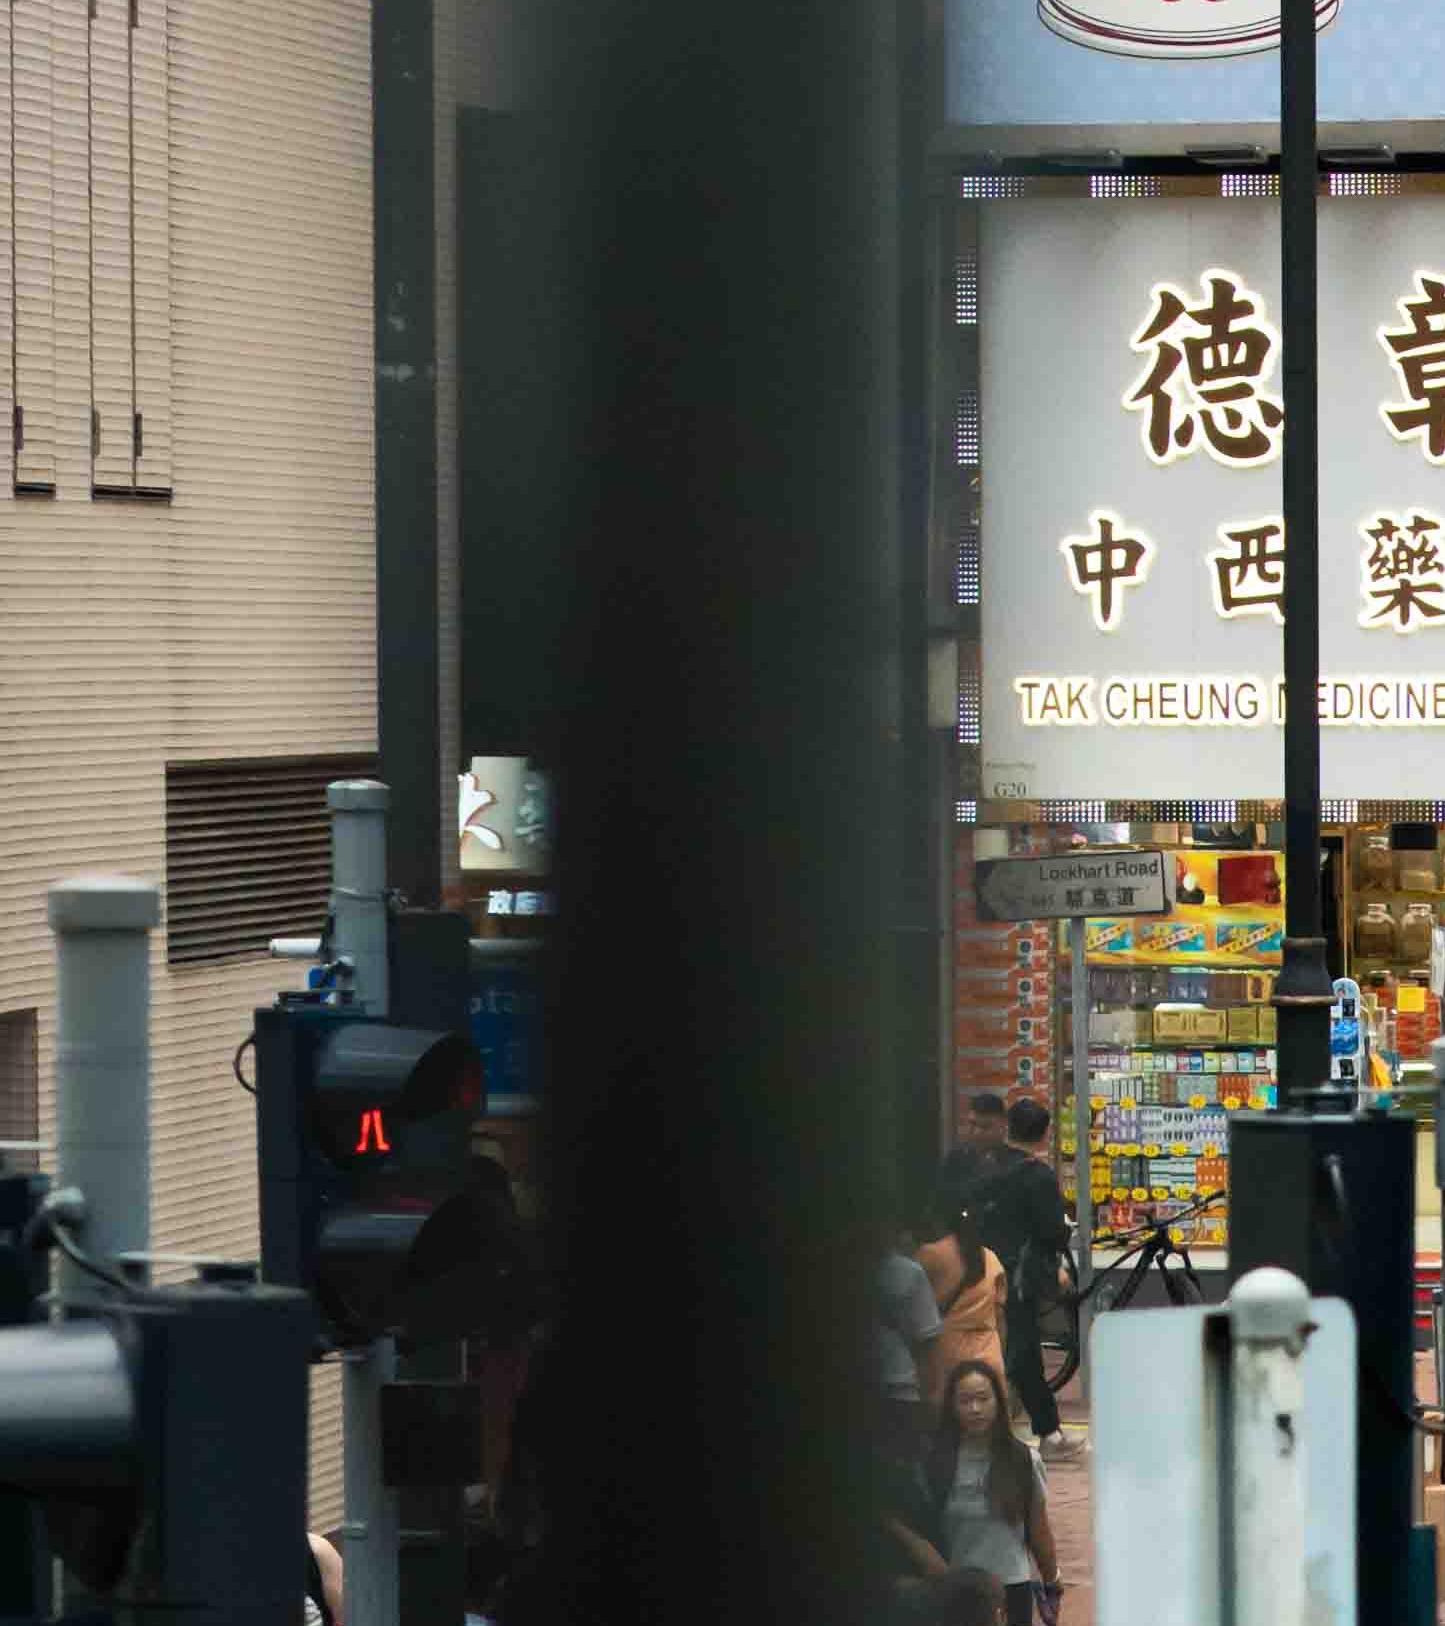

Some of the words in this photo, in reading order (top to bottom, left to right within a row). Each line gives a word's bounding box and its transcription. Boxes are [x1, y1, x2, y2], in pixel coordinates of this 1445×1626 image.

[1019, 681, 1090, 720] TAK
[1104, 681, 1260, 721] CHEUNG
[1038, 862, 1112, 882] Lockhart
[1115, 857, 1160, 878] Road
